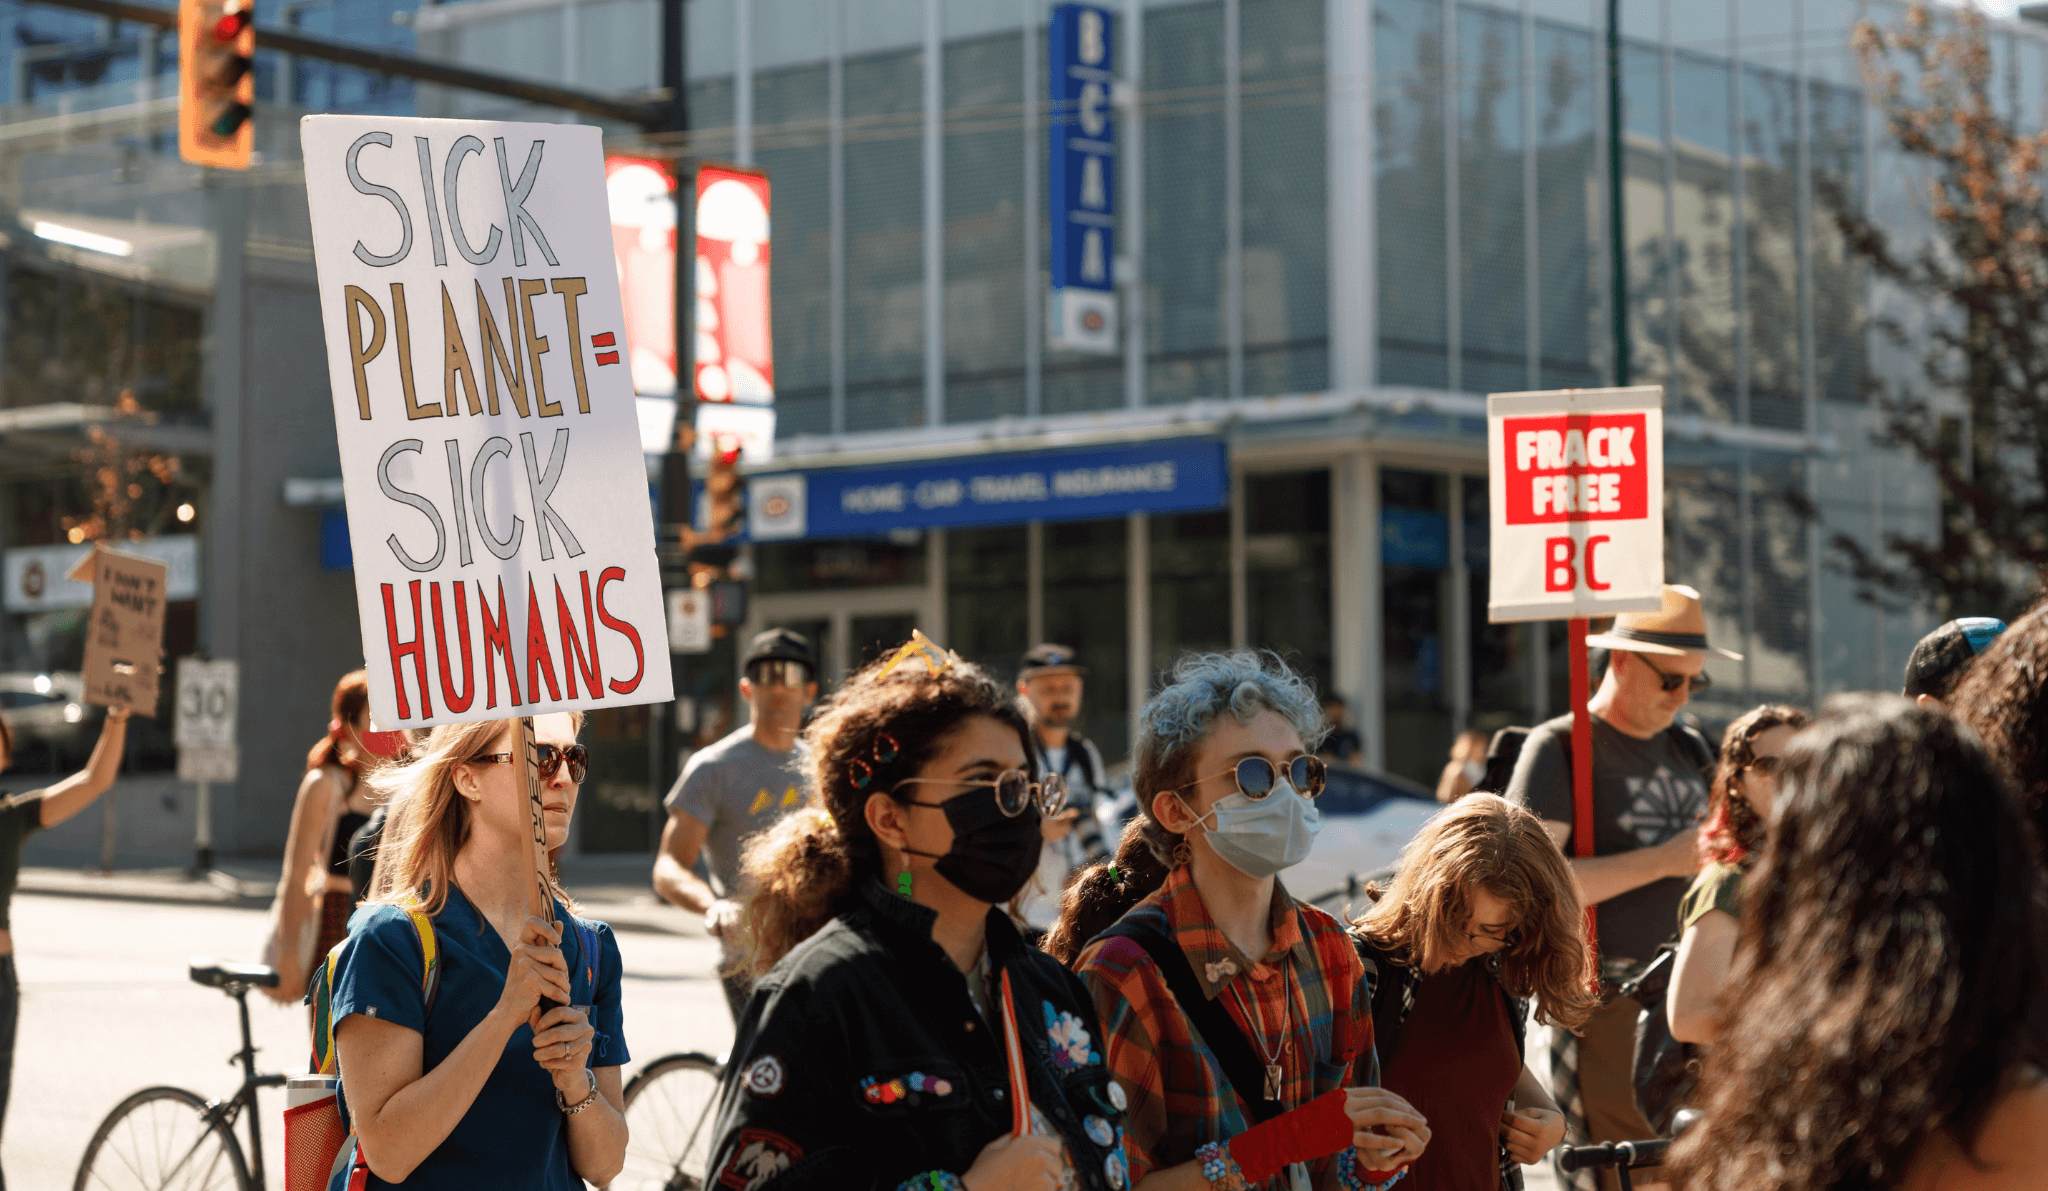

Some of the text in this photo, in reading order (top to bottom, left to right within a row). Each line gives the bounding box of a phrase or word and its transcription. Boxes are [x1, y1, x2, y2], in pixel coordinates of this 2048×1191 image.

[346, 132, 559, 267] SICK
[1516, 426, 1636, 471] FRACK
[1532, 473, 1621, 516] FREE
[377, 428, 585, 572] SICK
[1545, 535, 1611, 593] BC
[381, 567, 644, 720] HUMANS
